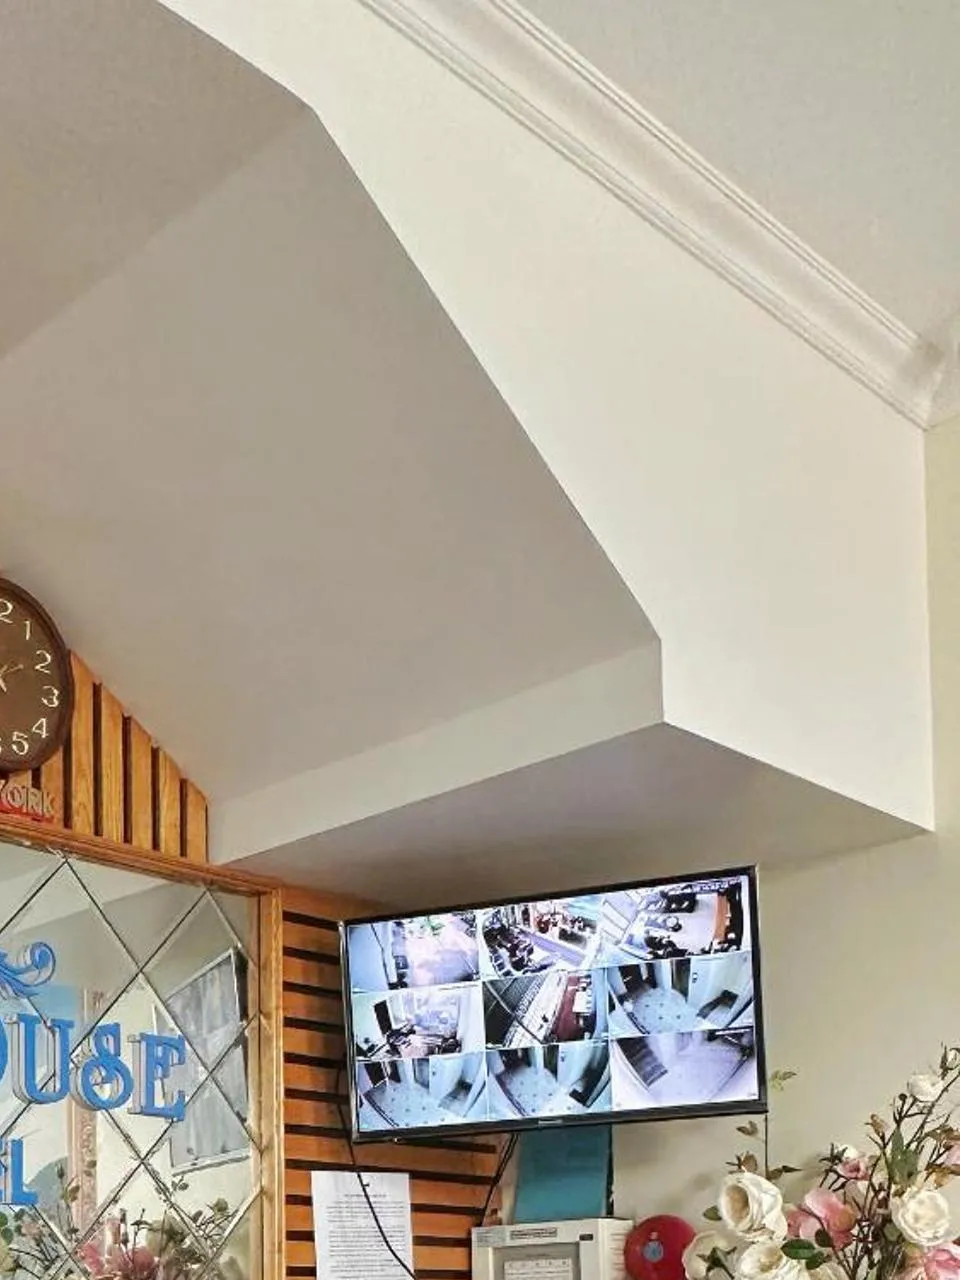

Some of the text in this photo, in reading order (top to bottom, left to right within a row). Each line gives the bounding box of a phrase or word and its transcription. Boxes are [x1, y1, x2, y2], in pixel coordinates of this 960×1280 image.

[23, 621, 30, 641] 1
[34, 650, 52, 674] 2
[41, 686, 59, 707] 3
[32, 718, 48, 738] 4
[12, 732, 29, 755] 5
